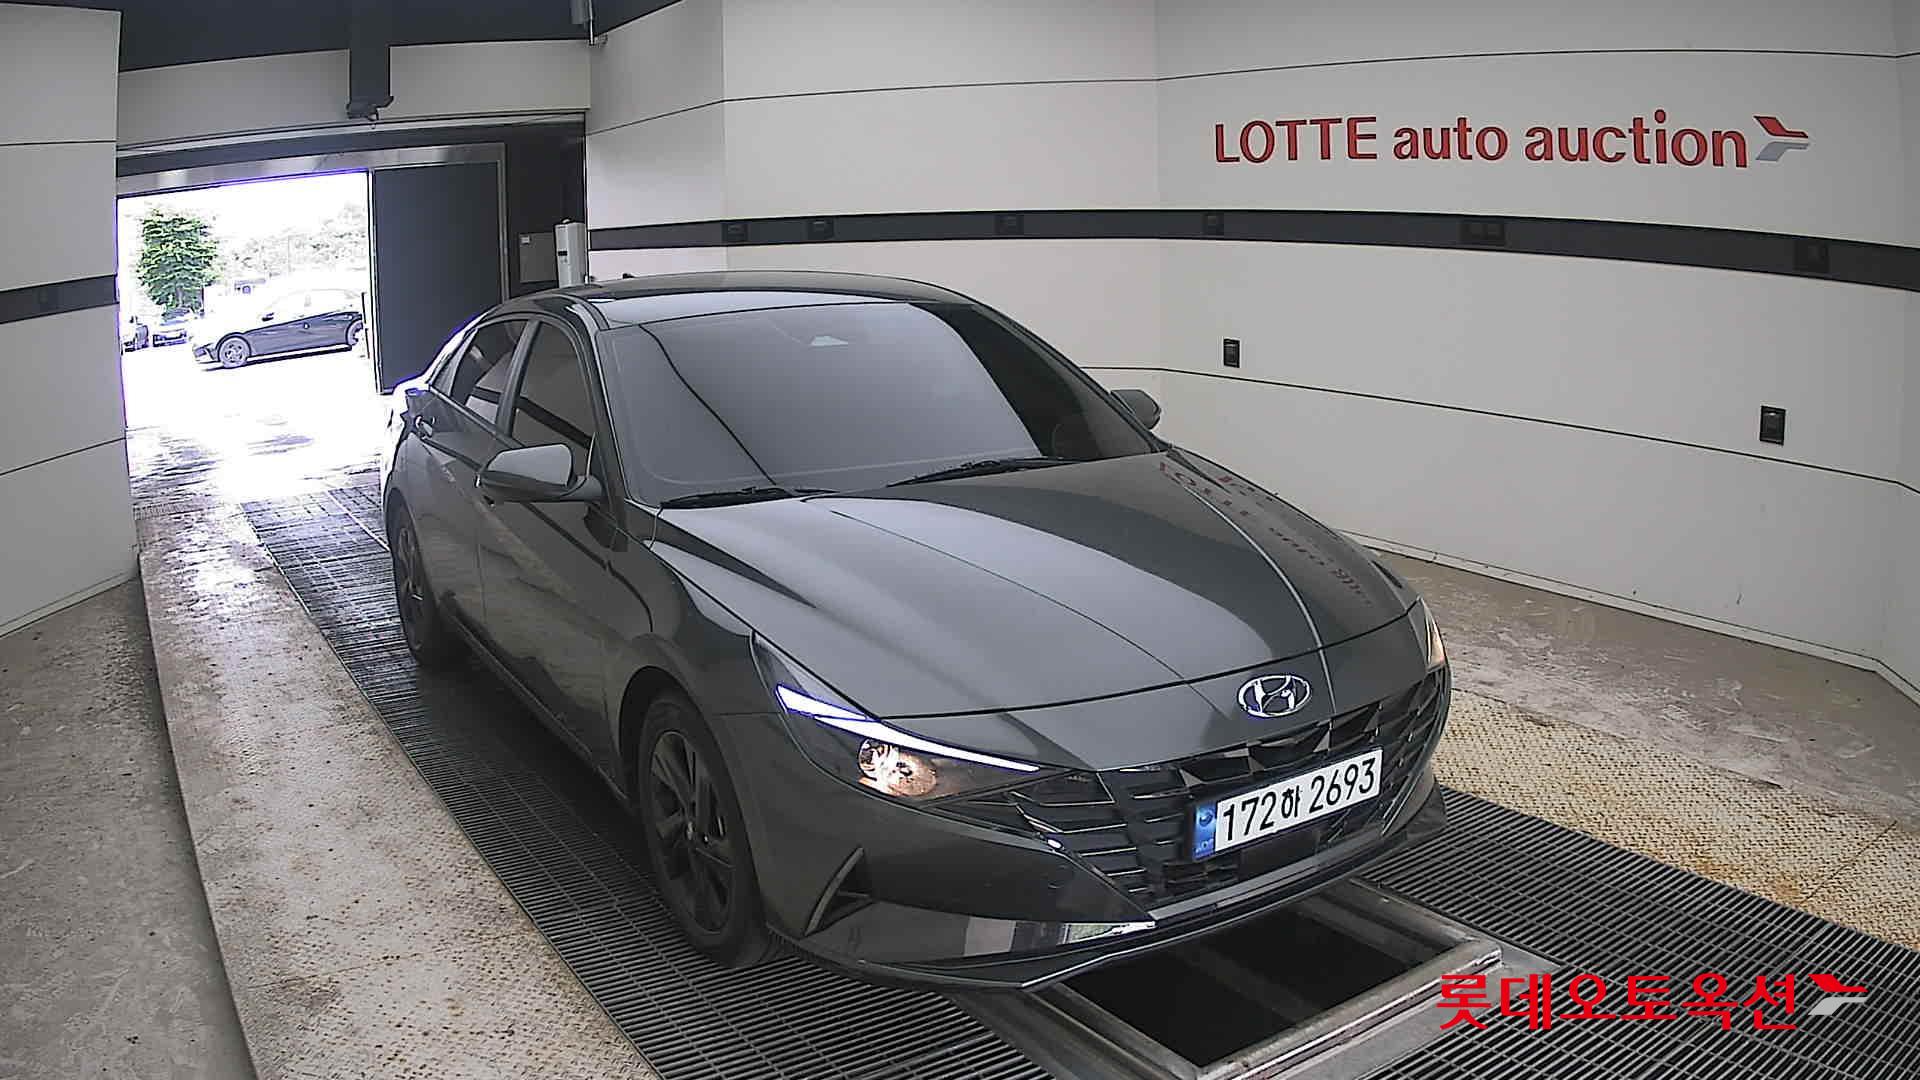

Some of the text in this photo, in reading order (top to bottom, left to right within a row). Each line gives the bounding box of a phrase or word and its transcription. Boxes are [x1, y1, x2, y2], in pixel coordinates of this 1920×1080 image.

[1215, 109, 1748, 168] LOTTE auto auction
[1223, 757, 1376, 841] 172하 2693
